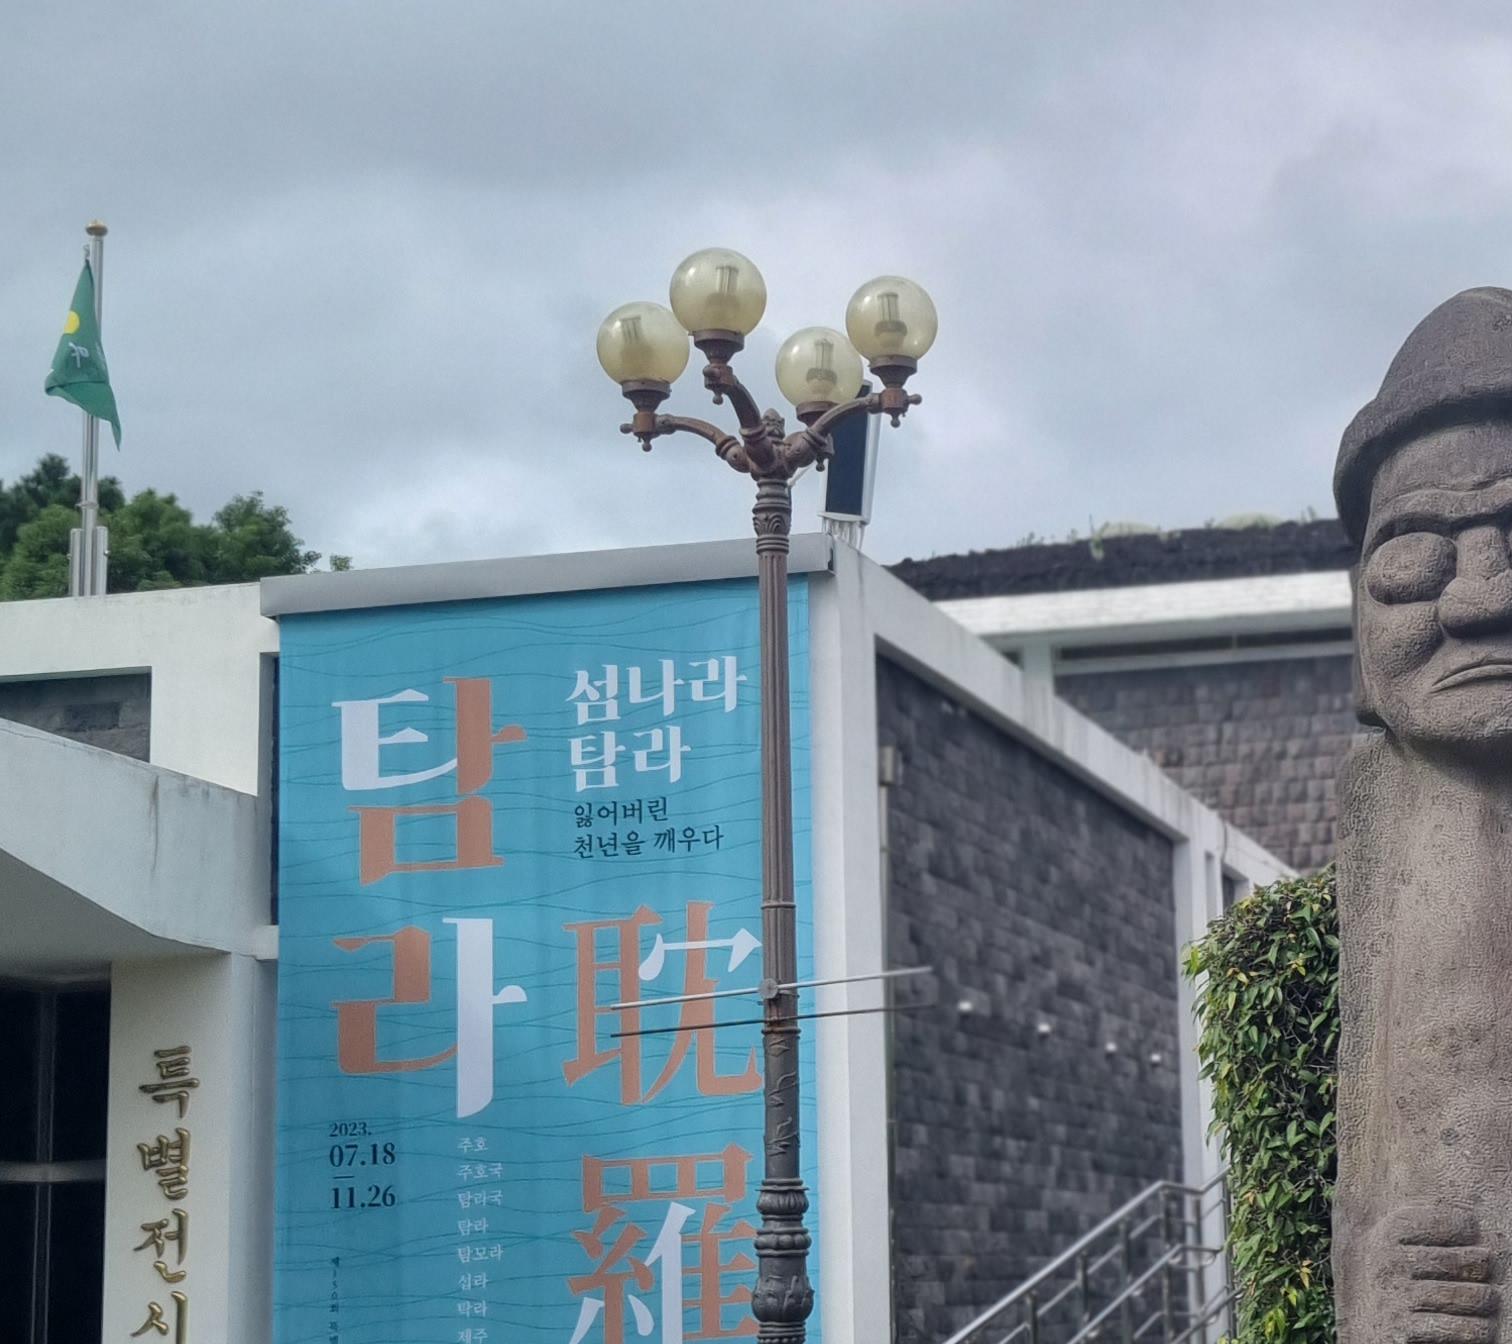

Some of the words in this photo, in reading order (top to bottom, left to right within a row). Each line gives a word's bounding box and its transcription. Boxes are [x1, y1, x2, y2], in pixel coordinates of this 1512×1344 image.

[566, 656, 747, 725] 섬나라
[567, 725, 692, 792] 탐라
[574, 796, 669, 828] 잃어버린
[574, 830, 646, 859] 천년을
[653, 824, 724, 853] 깨우다
[331, 677, 528, 1118] 탐라
[329, 1121, 372, 1137] 2023.
[329, 1142, 396, 1167] 07.18
[330, 1184, 396, 1209] 11.26
